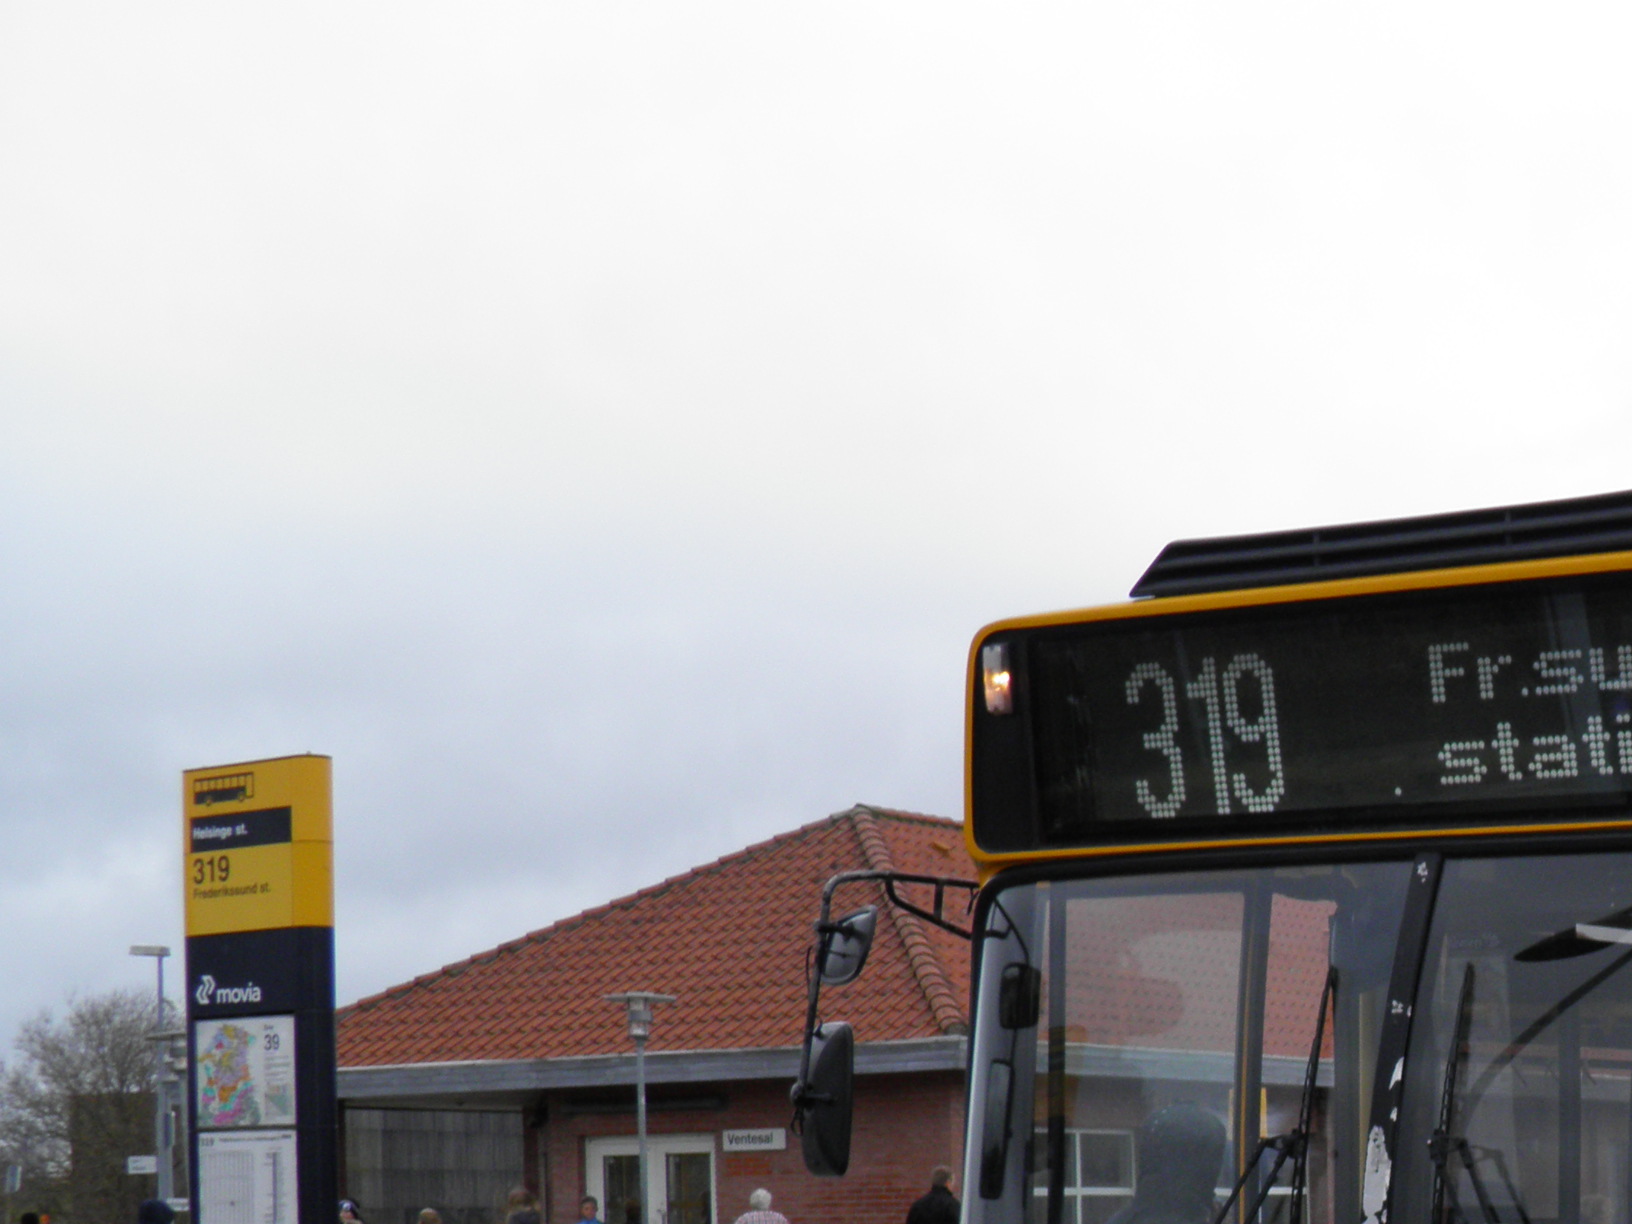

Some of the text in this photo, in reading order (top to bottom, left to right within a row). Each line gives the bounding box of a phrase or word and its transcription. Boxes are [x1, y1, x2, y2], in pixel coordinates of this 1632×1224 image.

[1125, 652, 1285, 818] 319
[192, 823, 248, 840] Helsinge st.
[193, 855, 230, 884] 319
[193, 882, 271, 899] Frederikssund st.
[216, 982, 262, 1004] movia
[263, 1034, 280, 1052] 39
[727, 1131, 774, 1145] Ventesal
